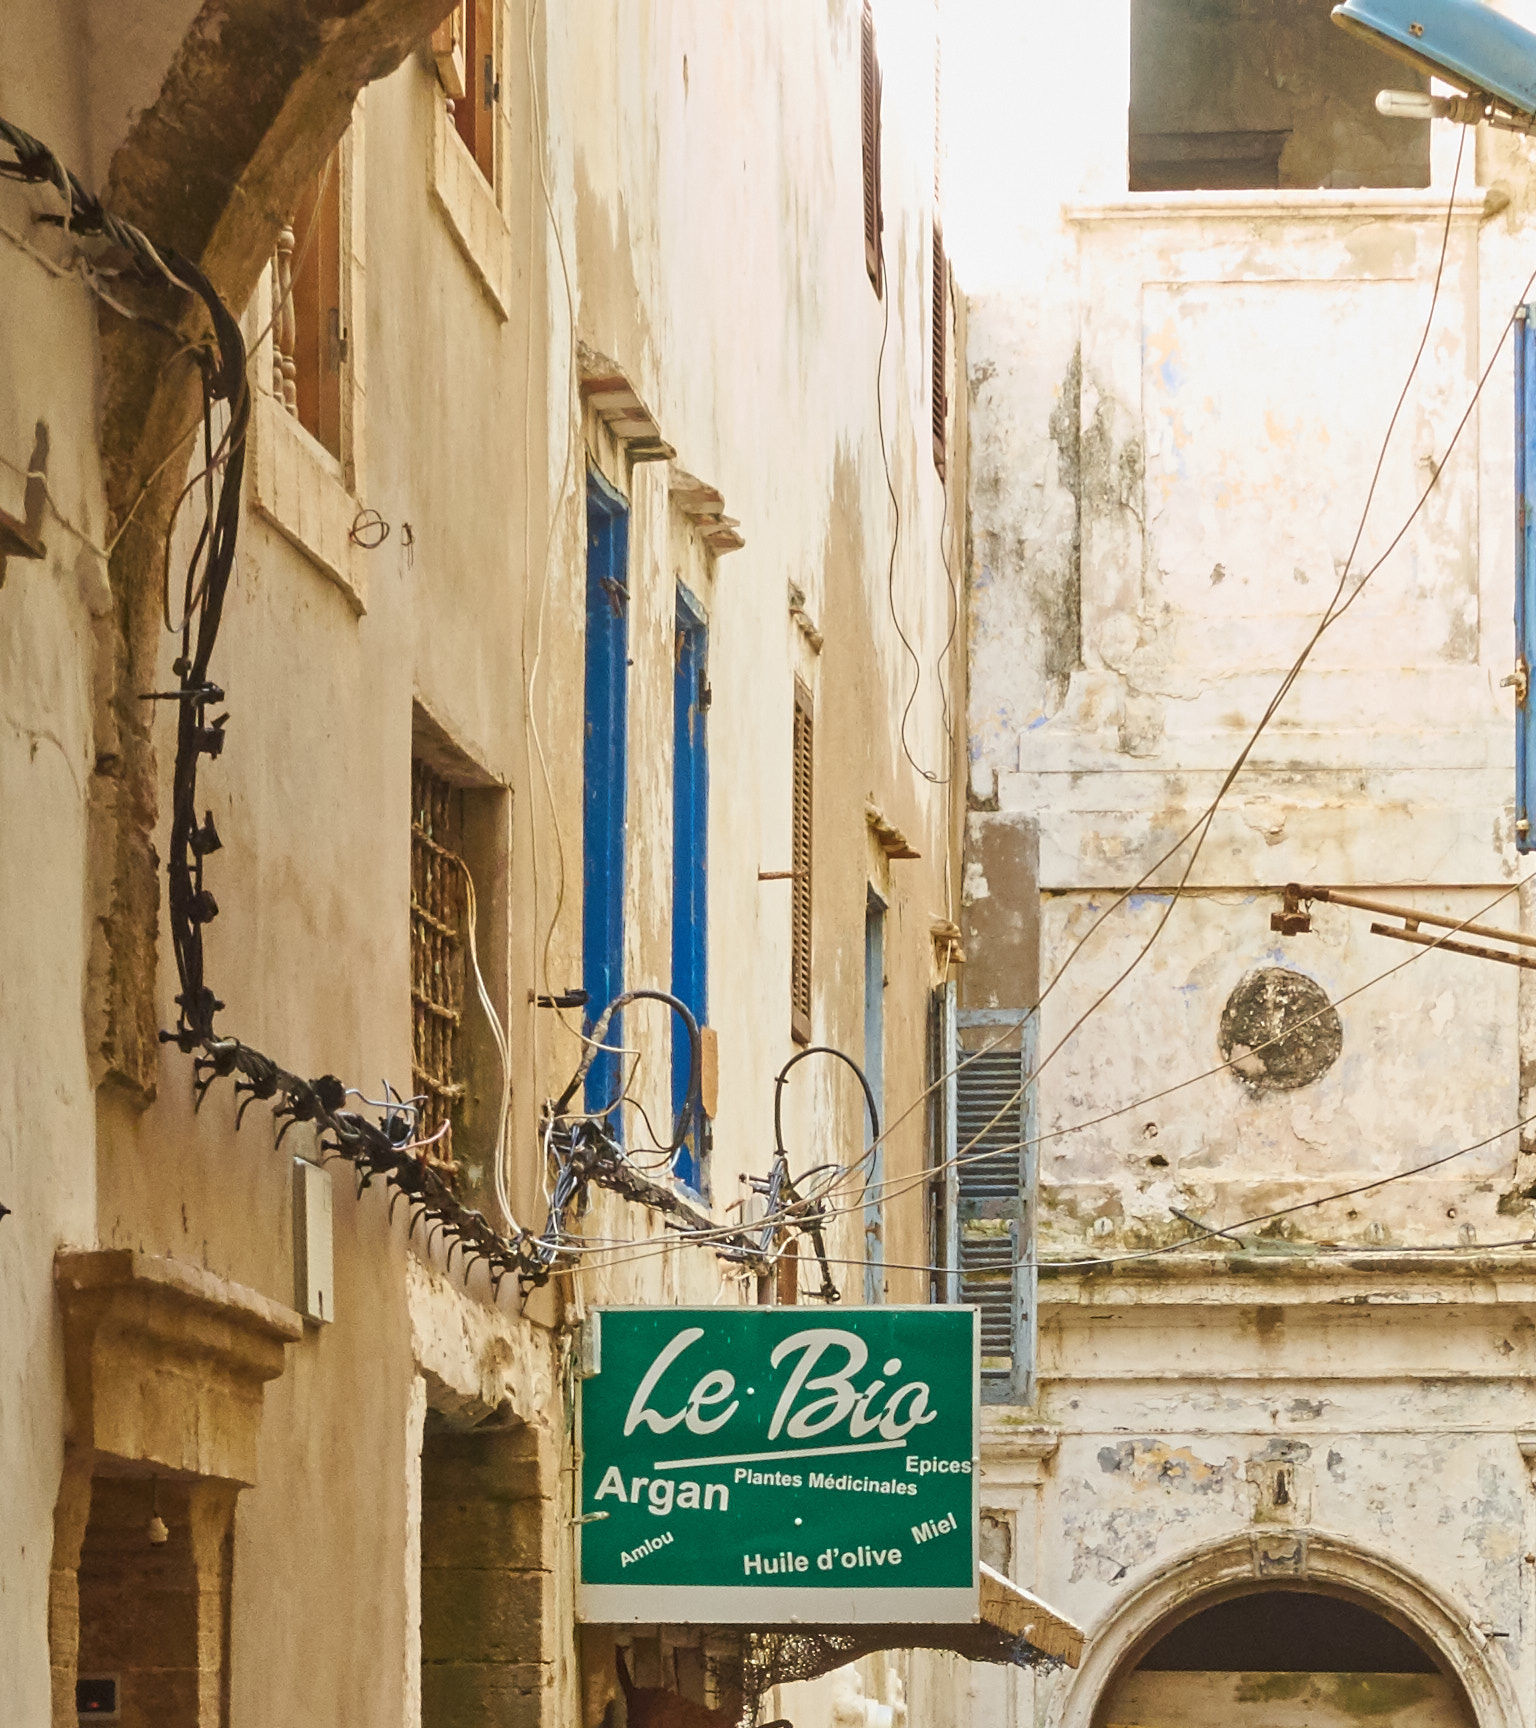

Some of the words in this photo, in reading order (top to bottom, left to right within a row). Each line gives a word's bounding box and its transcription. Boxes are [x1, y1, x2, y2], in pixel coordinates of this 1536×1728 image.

[624, 1327, 740, 1436] Le
[767, 1327, 937, 1441] Bio
[905, 1455, 972, 1475] Epices
[594, 1466, 731, 1516] Argan
[734, 1468, 803, 1488] Plantes
[808, 1472, 918, 1497] Médicinales
[911, 1512, 958, 1546] Miel
[619, 1531, 675, 1568] Amlou
[743, 1551, 809, 1576] Huile
[816, 1546, 903, 1571] d'olive
